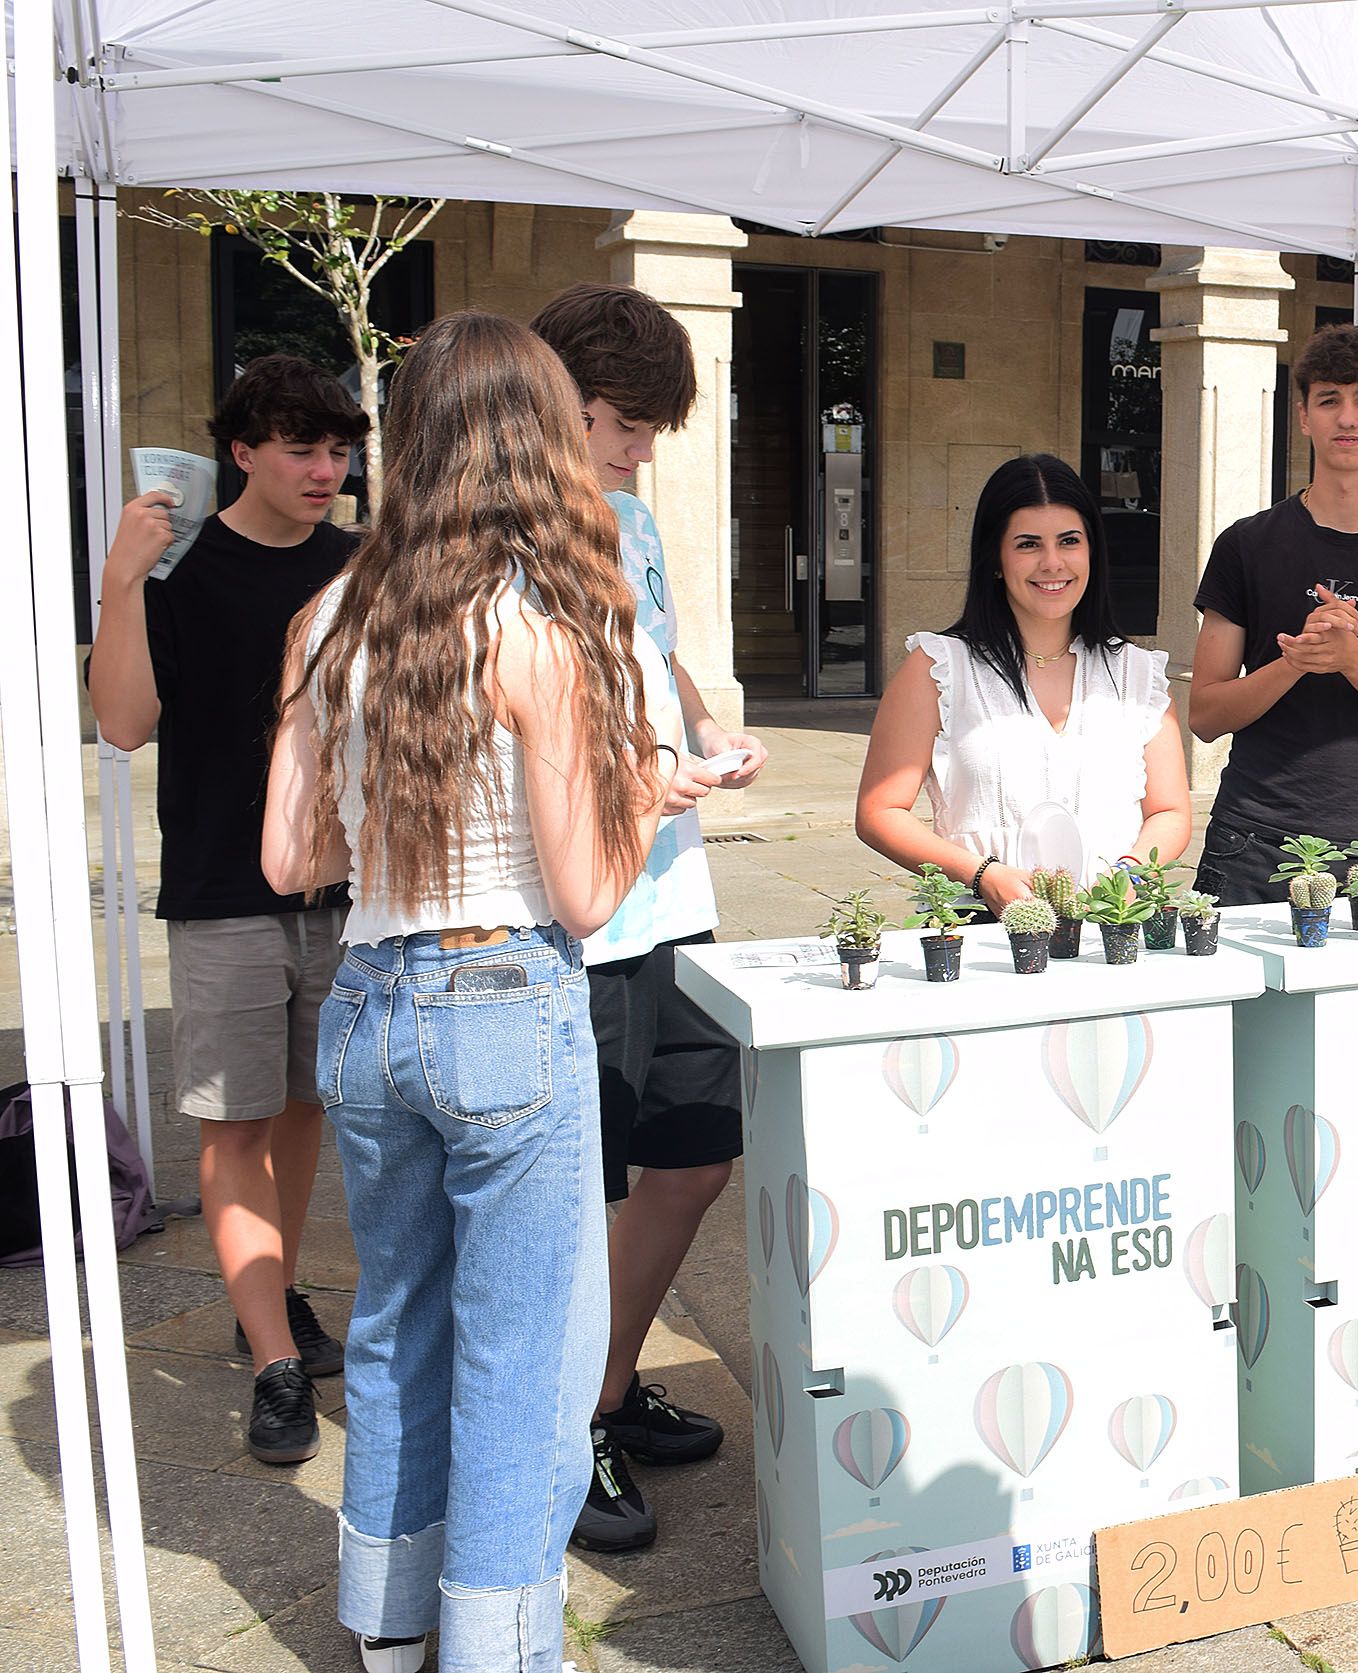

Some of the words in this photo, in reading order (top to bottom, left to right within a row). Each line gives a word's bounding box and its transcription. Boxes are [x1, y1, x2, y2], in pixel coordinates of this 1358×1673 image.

[884, 1174, 1172, 1260] DEPOEMPRENDE
[1052, 1237, 1096, 1284] NA
[1111, 1225, 1172, 1275] ESO
[1036, 1537, 1078, 1553] XUNTA
[918, 1556, 986, 1579] Deputación
[1035, 1554, 1051, 1566] DE
[918, 1567, 987, 1588] Pontevedra
